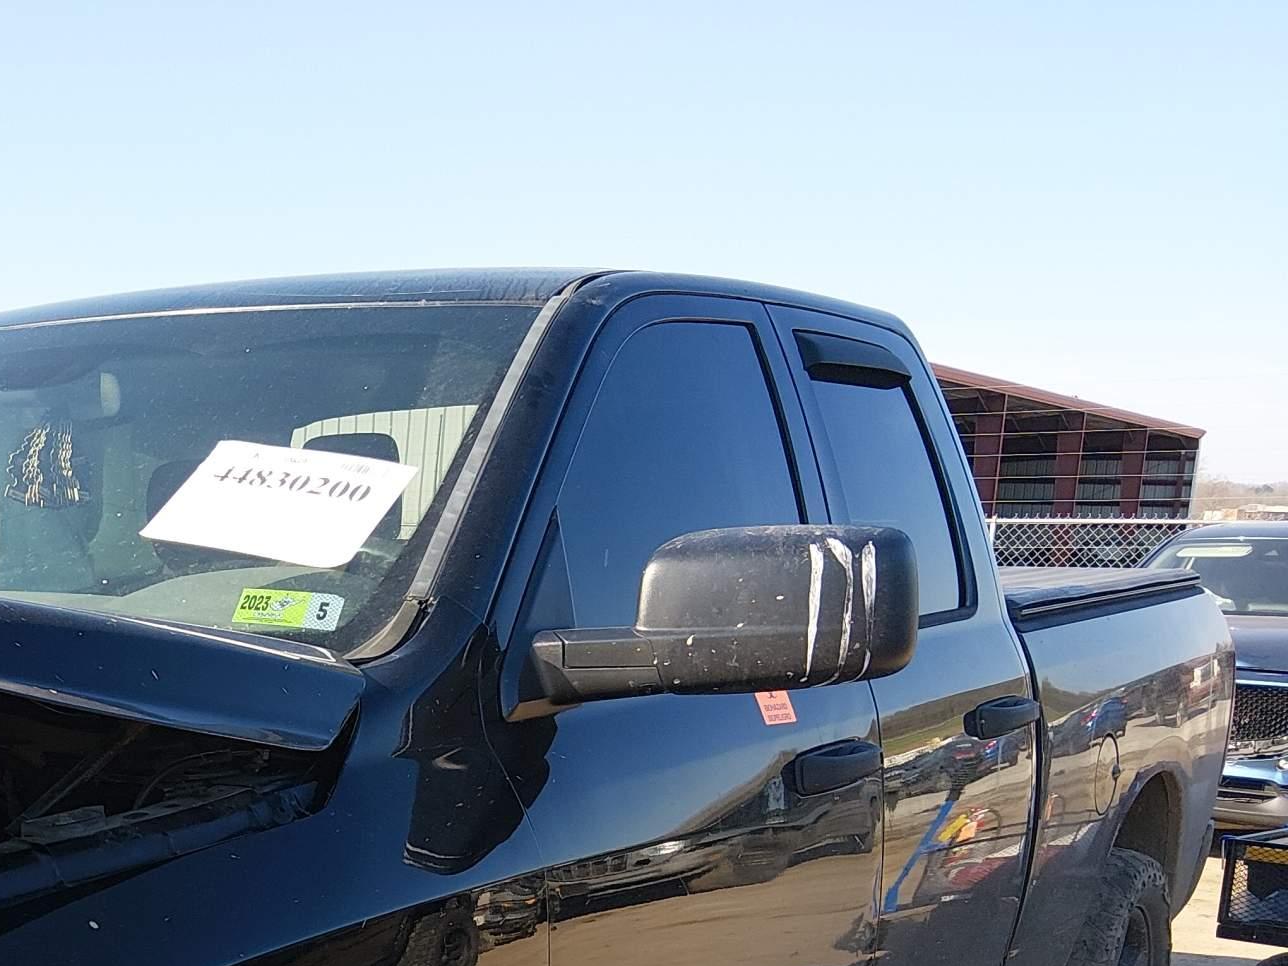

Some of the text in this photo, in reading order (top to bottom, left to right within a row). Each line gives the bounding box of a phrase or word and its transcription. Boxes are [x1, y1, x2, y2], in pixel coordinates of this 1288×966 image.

[213, 465, 373, 502] 44830200
[240, 594, 330, 621] 2023 5
